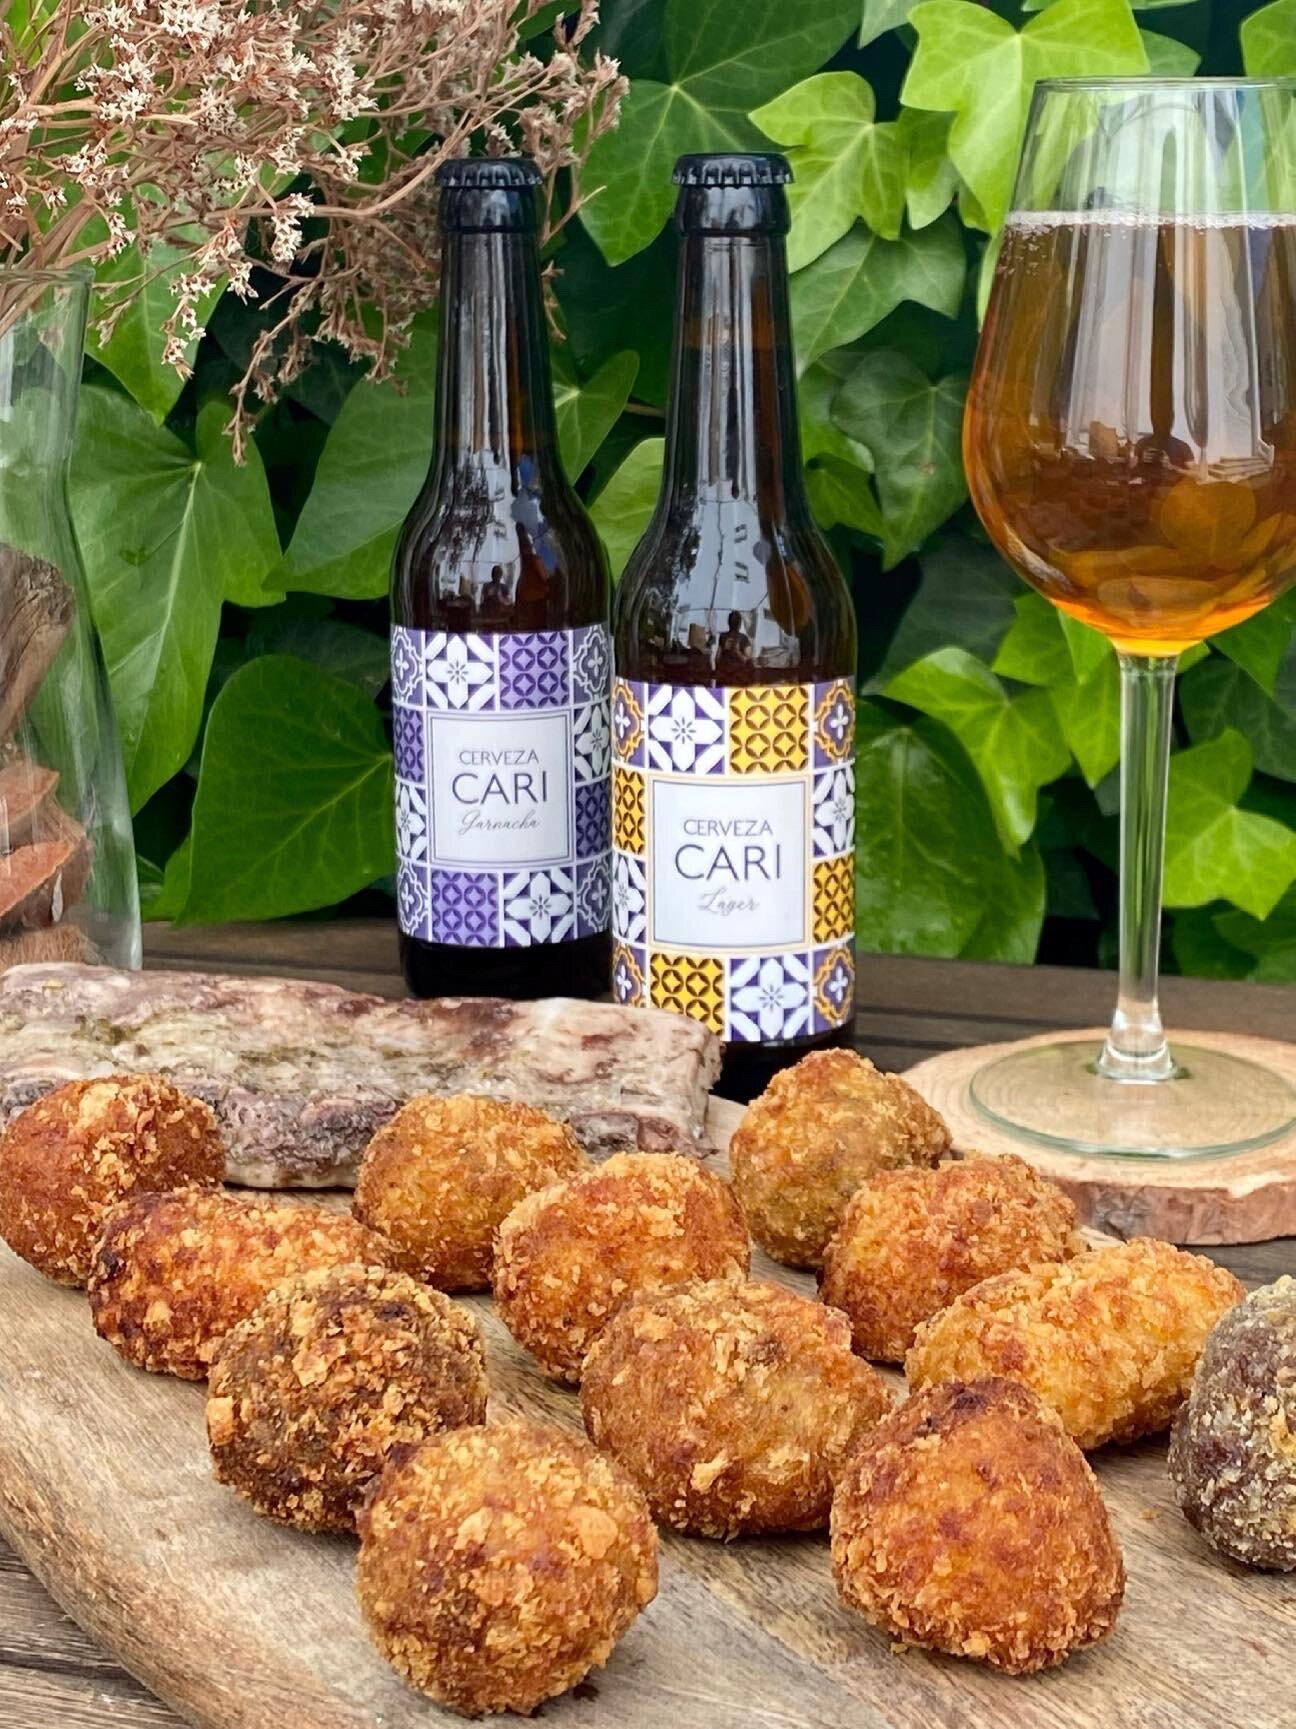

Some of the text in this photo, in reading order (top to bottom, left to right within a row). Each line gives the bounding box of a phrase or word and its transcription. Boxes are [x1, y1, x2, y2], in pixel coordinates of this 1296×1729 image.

[459, 749, 540, 766] CERVEZA
[451, 771, 548, 805] CARI
[457, 809, 541, 836] Garnacha
[683, 819, 773, 837] CERVEZA
[674, 844, 782, 881] CARI
[698, 887, 760, 915] Lager
